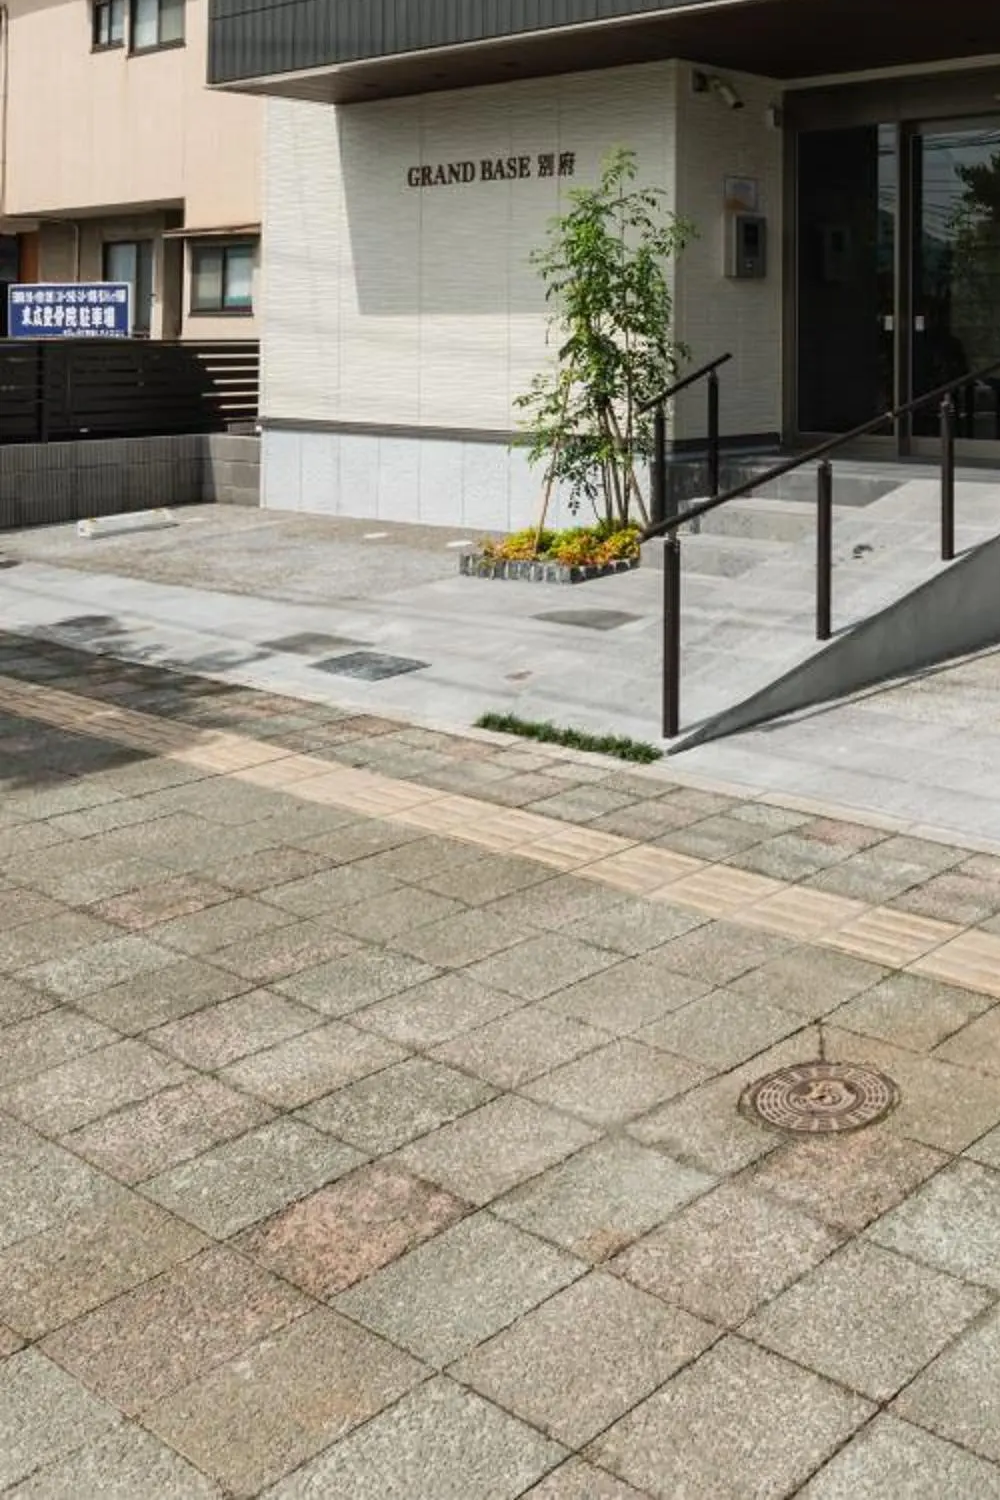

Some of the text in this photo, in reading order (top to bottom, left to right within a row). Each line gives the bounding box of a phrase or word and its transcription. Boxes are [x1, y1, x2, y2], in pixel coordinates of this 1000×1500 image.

[407, 151, 576, 187] GRAND BASE 別府
